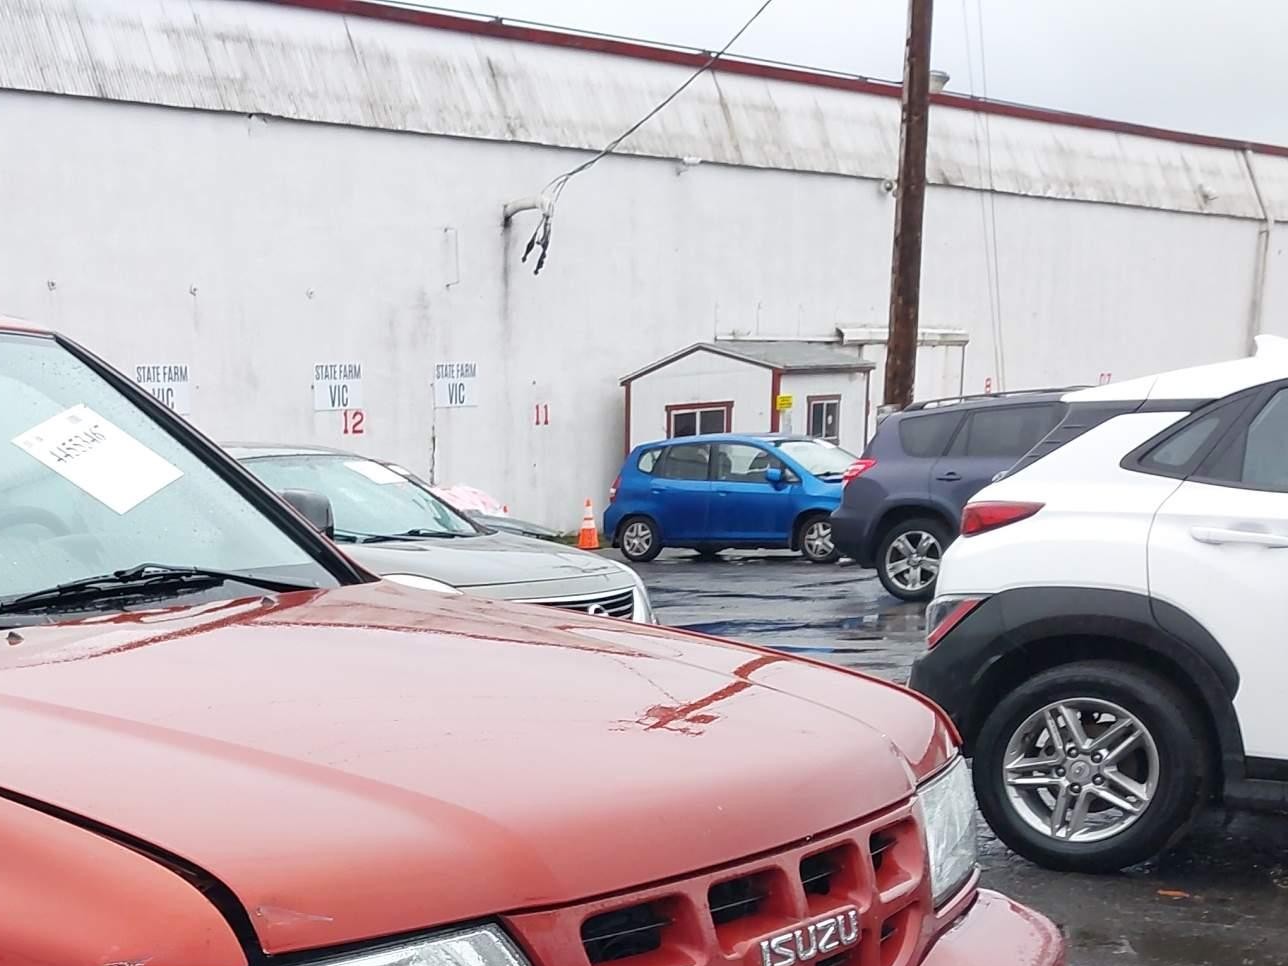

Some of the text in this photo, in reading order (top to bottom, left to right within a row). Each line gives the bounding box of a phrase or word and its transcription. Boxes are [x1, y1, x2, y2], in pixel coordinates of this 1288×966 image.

[136, 365, 188, 383] STATE FARM
[315, 363, 361, 380] STATE FARM
[436, 363, 476, 379] STATE FARM
[329, 385, 349, 407] VIC
[448, 383, 465, 404] VIC
[343, 411, 364, 434] 12
[535, 404, 549, 425] 11
